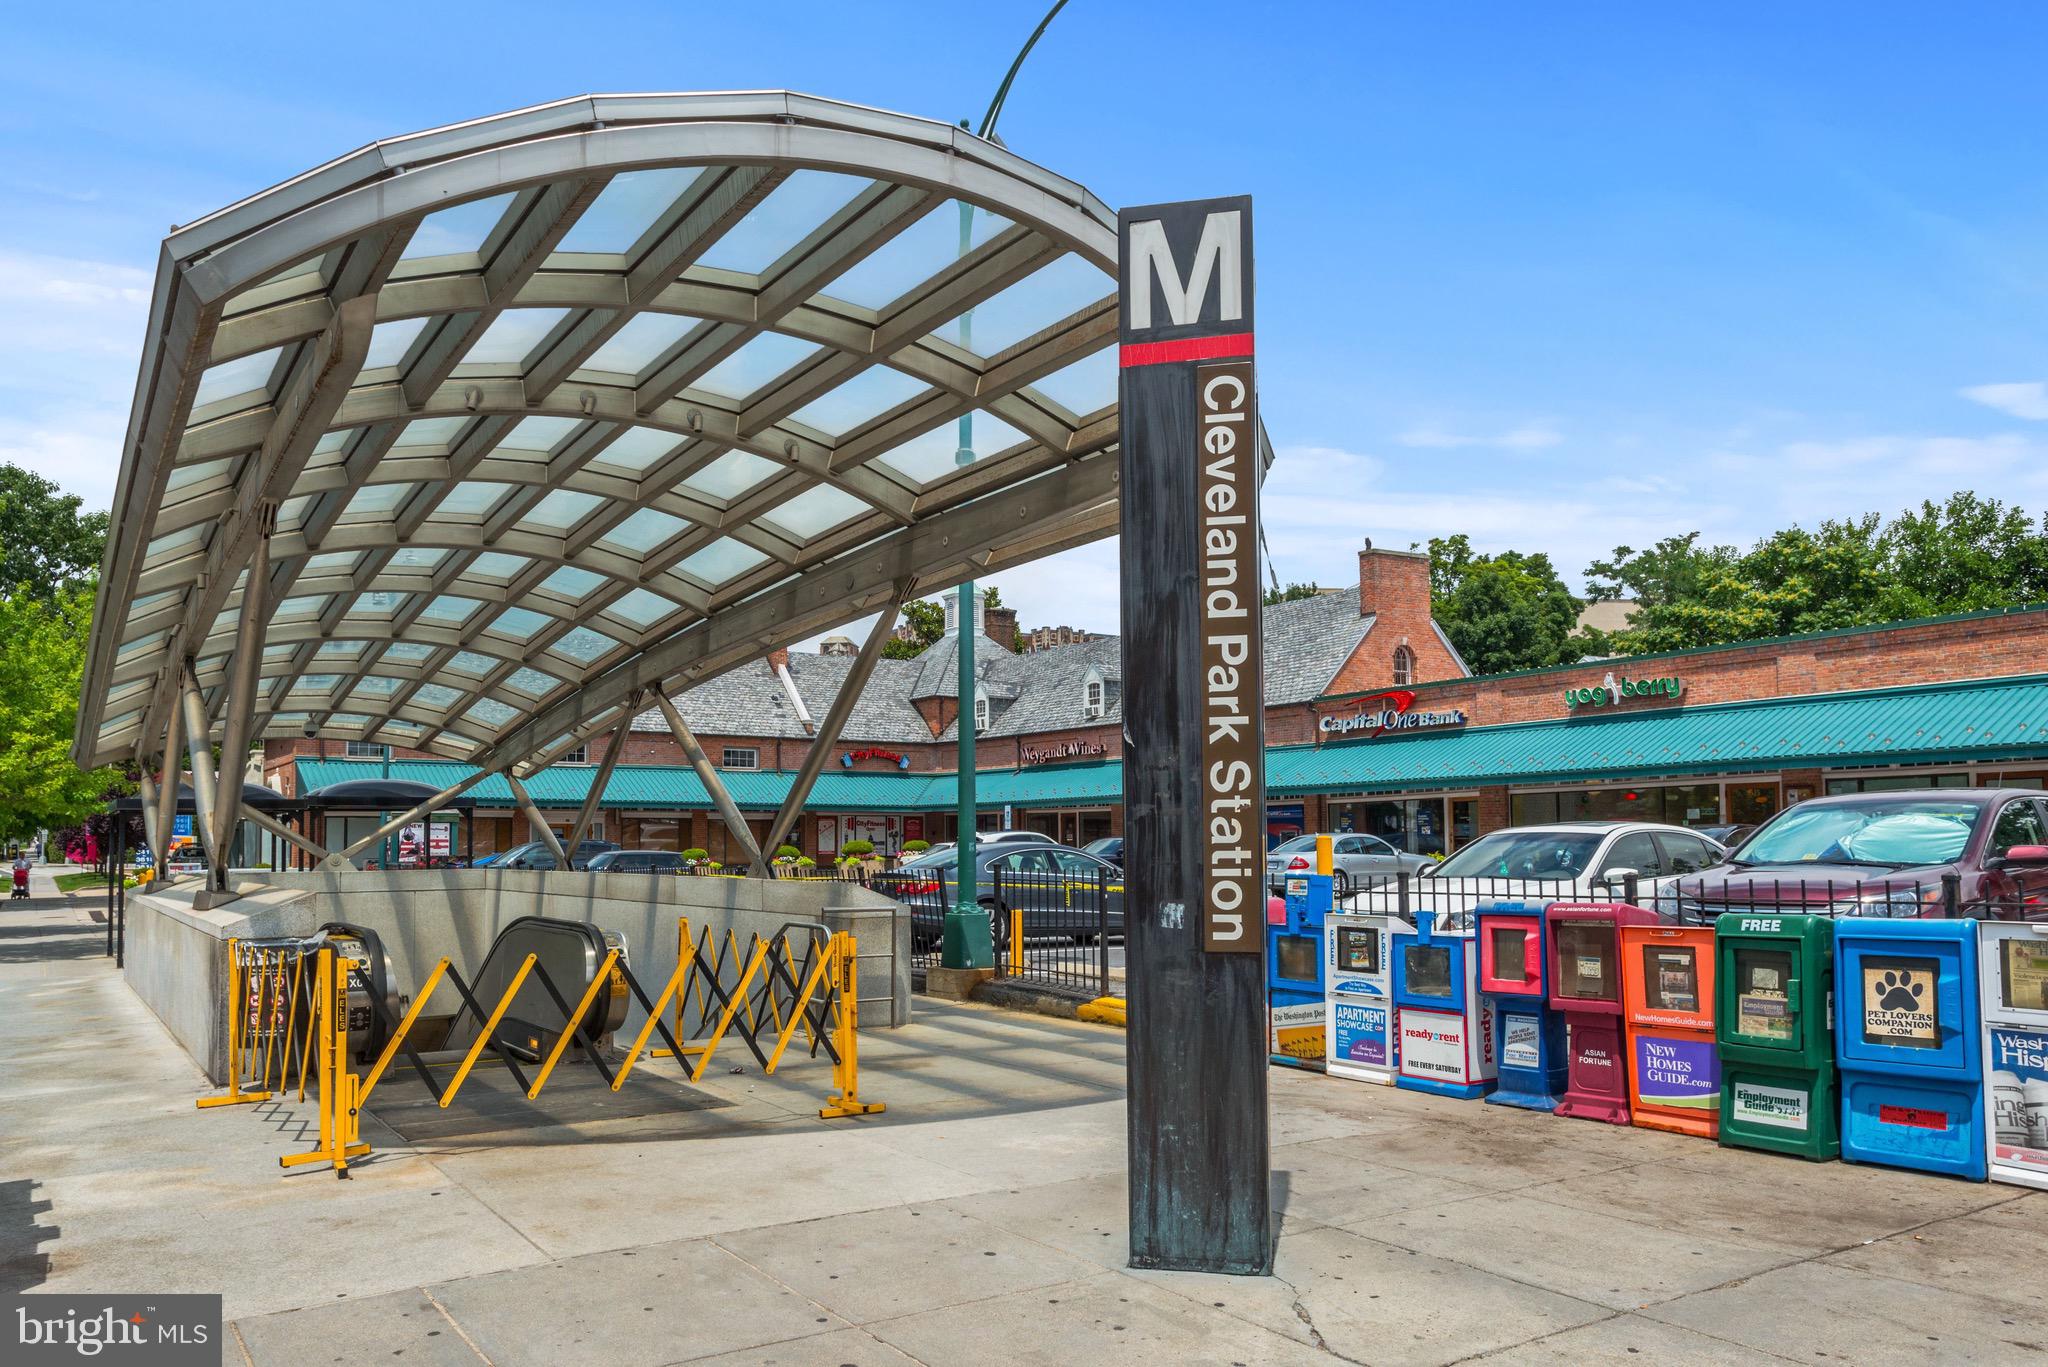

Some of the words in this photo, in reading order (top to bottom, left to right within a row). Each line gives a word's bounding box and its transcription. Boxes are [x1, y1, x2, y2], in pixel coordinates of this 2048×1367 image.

[1129, 210, 1242, 330] M
[1204, 375, 1248, 619] Cleveland
[1207, 635, 1249, 744] Park
[1419, 710, 1462, 726] Bank
[1022, 743, 1067, 764] Weygandt
[1069, 741, 1101, 755] Wines
[1210, 760, 1252, 941] Station
[1741, 919, 1782, 932] FREE
[1274, 1013, 1283, 1022] The
[1284, 1011, 1313, 1021] Washington
[1337, 1006, 1385, 1025] APARTMENT
[1635, 1013, 1714, 1028] NewHomesGuide.com
[1868, 1010, 1887, 1018] PET
[1890, 1011, 1932, 1021] LOVERS
[1337, 1019, 1373, 1032] SHOWCASE
[1868, 1018, 1932, 1029] COMPANION
[1481, 1007, 1493, 1064] ready
[1584, 1049, 1606, 1057] ASIAN
[1645, 1043, 1676, 1057] NEW
[1408, 1060, 1419, 1069] FREE
[1419, 1061, 1434, 1071] EVERY
[1435, 1063, 1461, 1075] SATURDAY
[1578, 1056, 1612, 1067] FORTUNE
[1647, 1056, 1692, 1073] HOMES
[1647, 1069, 1712, 1089] GUIDE.com
[1737, 1089, 1801, 1108] Employment
[1744, 1100, 1774, 1112] Guide
